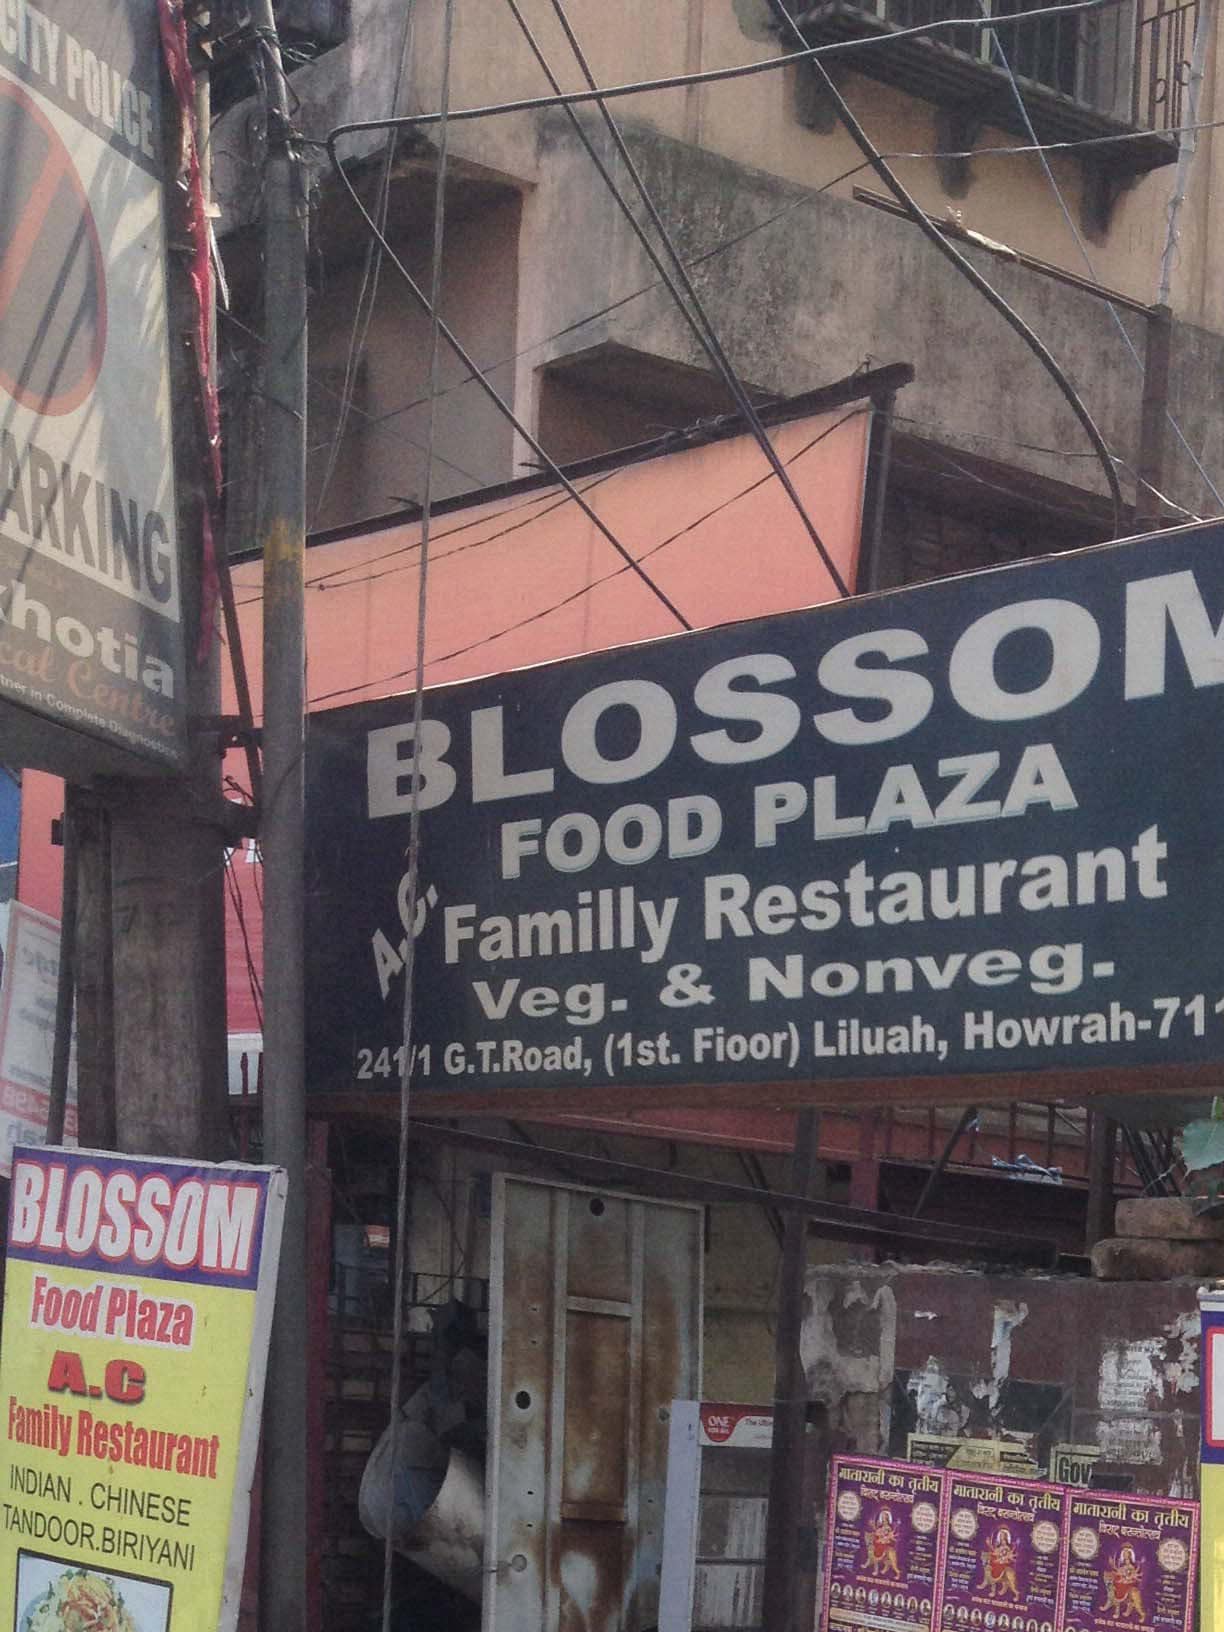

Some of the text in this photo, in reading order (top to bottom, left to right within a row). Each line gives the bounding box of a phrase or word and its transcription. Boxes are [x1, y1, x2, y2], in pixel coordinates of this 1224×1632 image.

[65, 33, 155, 160] POLICE
[501, 743, 1079, 880] FOOD PLAZA
[444, 822, 1168, 965] Familly Restaurant
[472, 978, 628, 1026] Veg.
[659, 962, 716, 1008] &
[443, 1036, 593, 1078] G.T.Road,
[604, 1031, 681, 1077] (1st.
[813, 1016, 949, 1061] Liluah,
[10, 1162, 259, 1272] BLOSSOM
[31, 1276, 194, 1346] Food Plaza
[47, 1350, 147, 1406] A.C
[8, 1396, 220, 1479] Family Restaurant
[10, 1465, 72, 1504] INDIAN
[90, 1483, 192, 1528] CHINESE
[888, 1474, 905, 1488] का
[908, 1476, 940, 1495] तृतीय
[1007, 1491, 1025, 1506] का
[1028, 1492, 1061, 1514] तृतीय
[3, 1505, 195, 1571] TANDOOR.BIRIYANI
[1131, 1509, 1149, 1523] का
[1154, 1508, 1190, 1532] तृतीय
